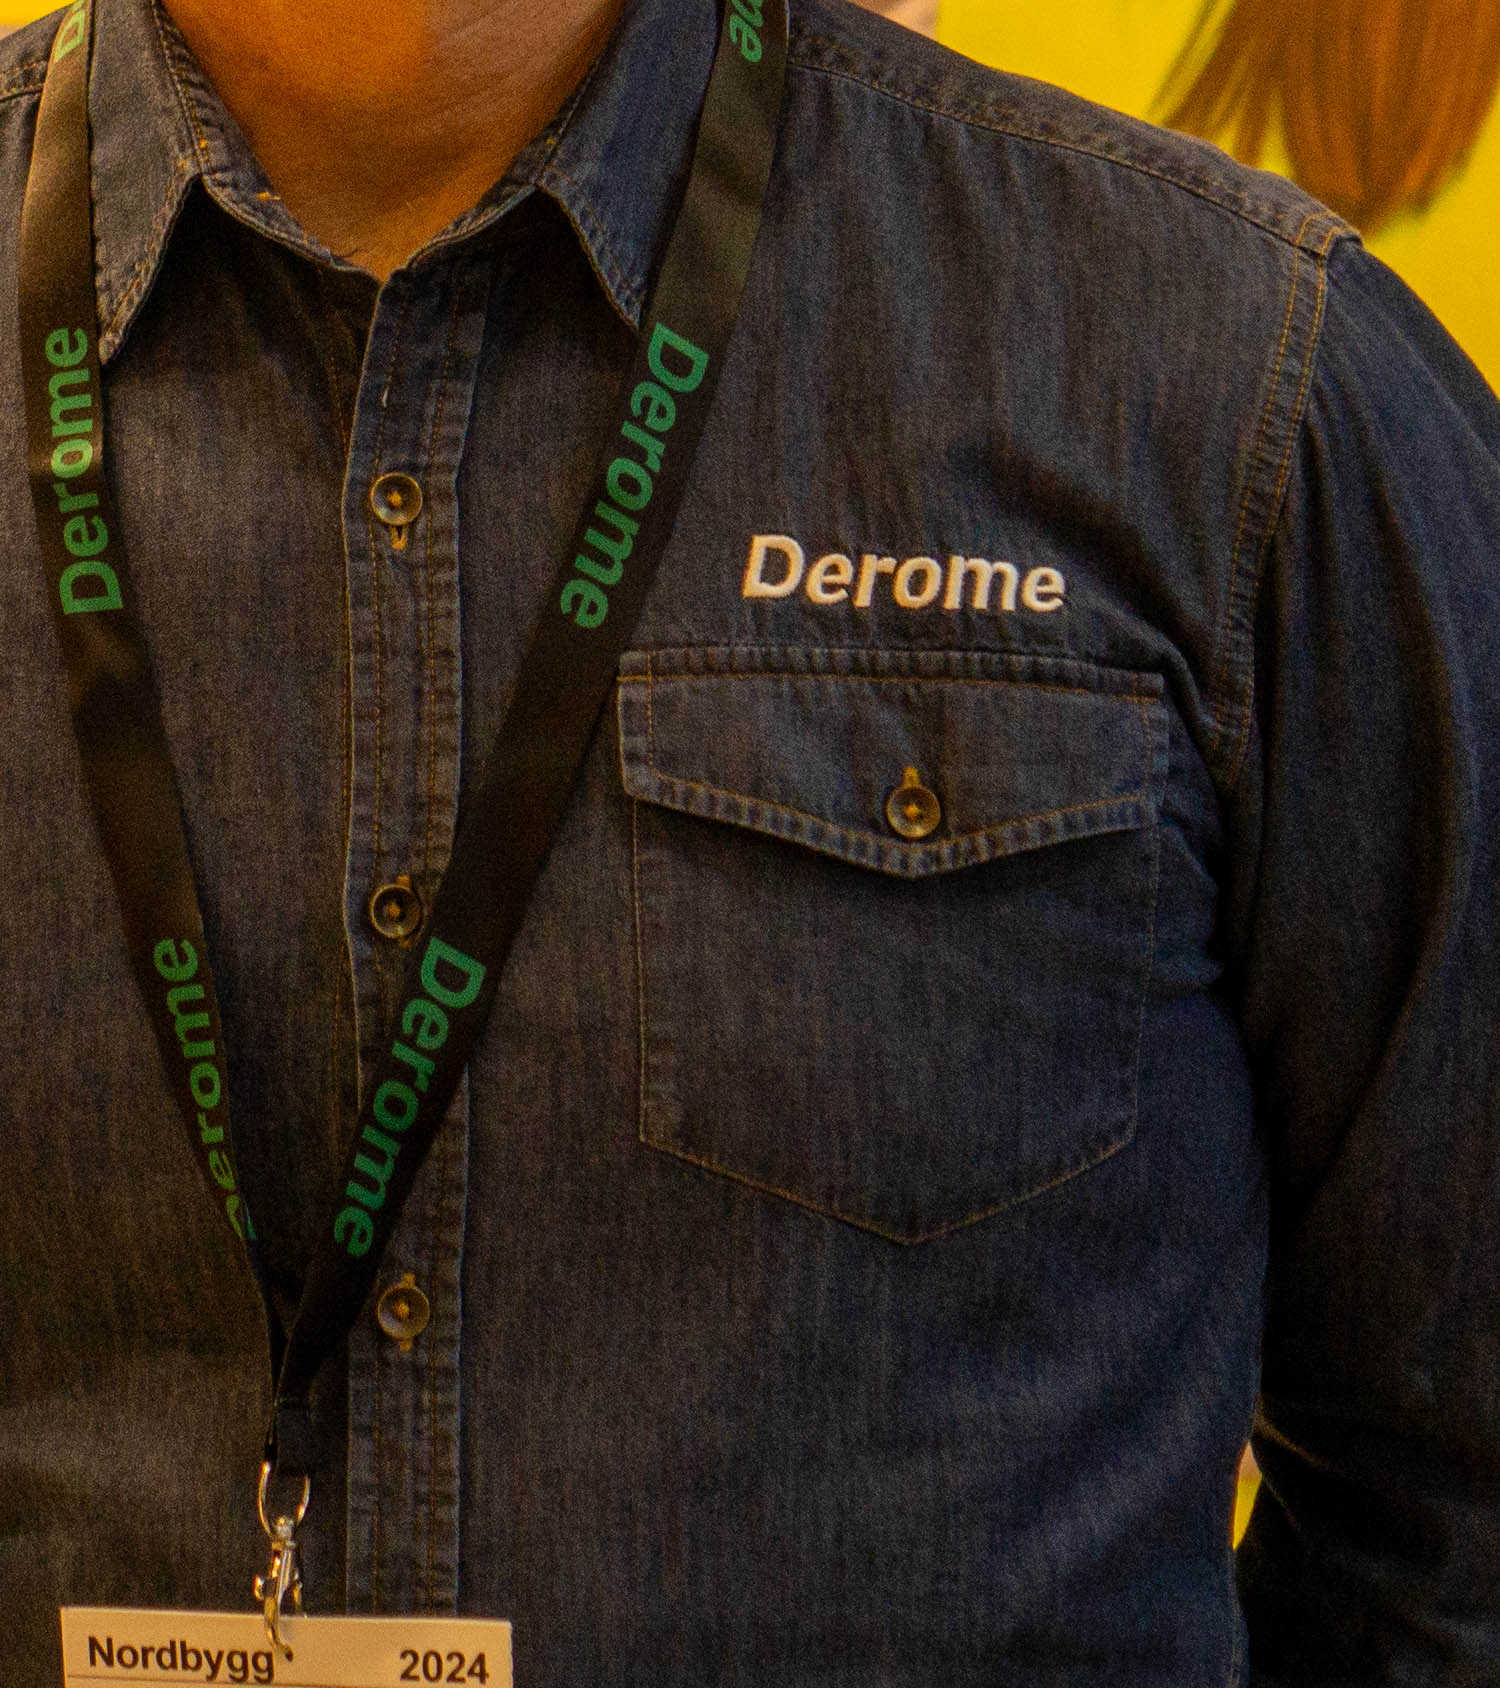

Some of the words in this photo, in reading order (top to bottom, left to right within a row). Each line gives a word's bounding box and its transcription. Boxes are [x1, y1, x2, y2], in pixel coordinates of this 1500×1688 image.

[45, 327, 123, 614] Derome
[560, 322, 709, 629] Derome
[742, 534, 1066, 612] Derome
[334, 936, 487, 1257] Derome
[87, 1635, 275, 1685] Nordbygg
[400, 1650, 490, 1684] 2024
